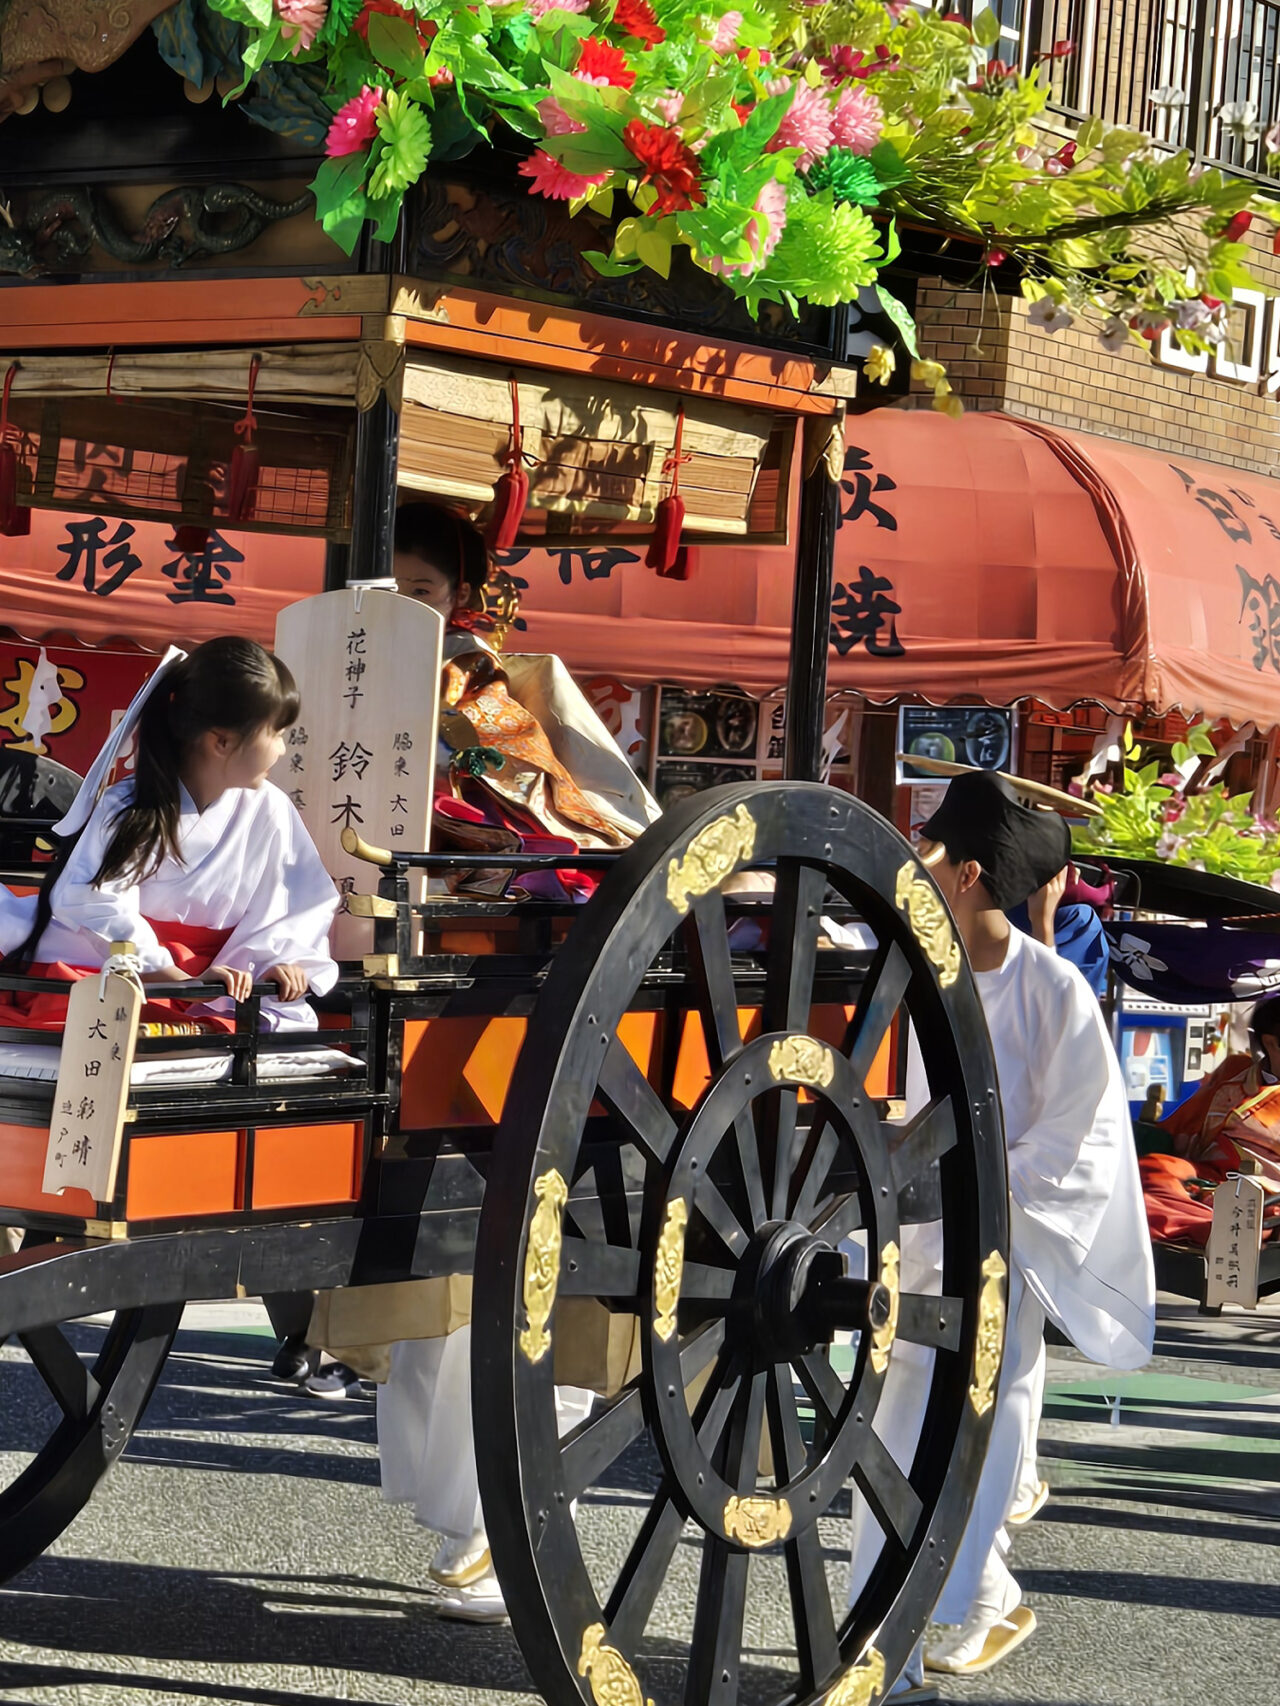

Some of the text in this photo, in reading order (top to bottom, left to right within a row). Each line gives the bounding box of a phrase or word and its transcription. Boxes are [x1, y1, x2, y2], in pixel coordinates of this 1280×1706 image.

[328, 628, 374, 829] 花神子 鈴木
